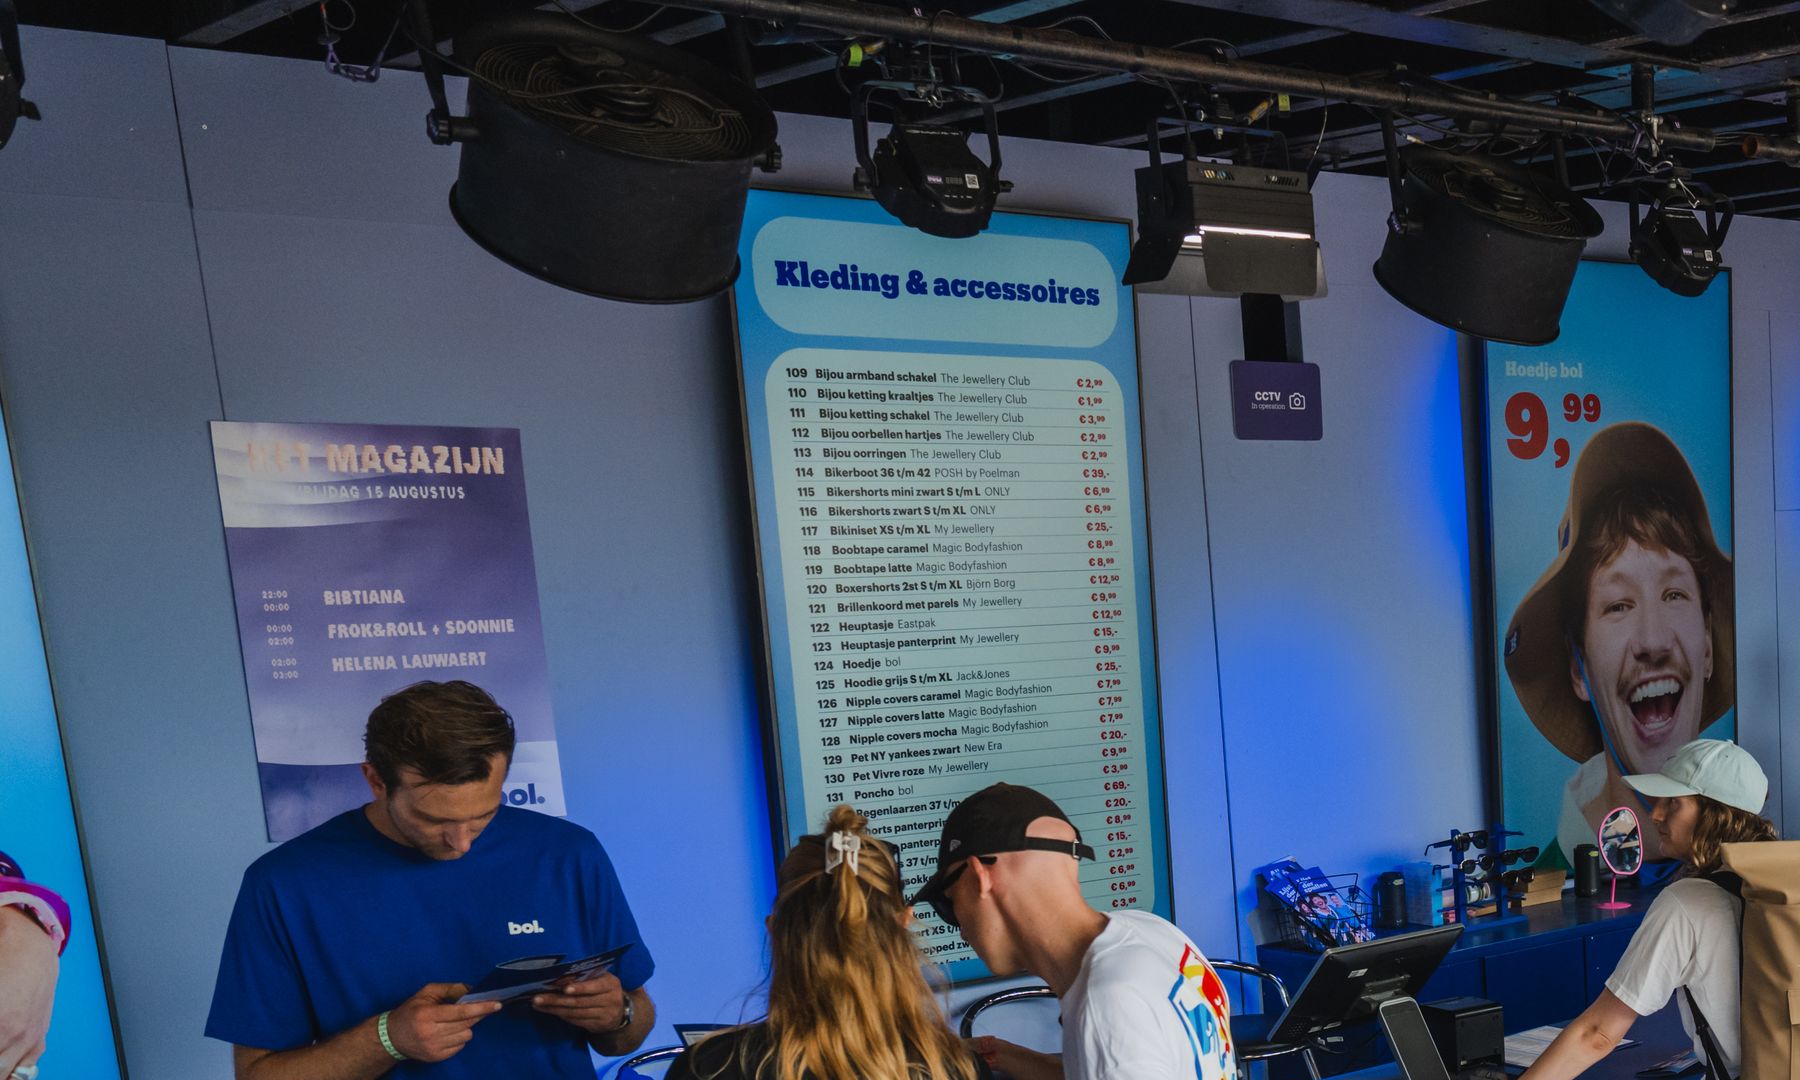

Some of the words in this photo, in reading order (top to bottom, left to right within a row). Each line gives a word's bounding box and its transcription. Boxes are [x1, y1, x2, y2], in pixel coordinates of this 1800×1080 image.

[774, 260, 900, 298] Kleding
[905, 270, 929, 295] &
[933, 277, 1100, 306] accessoires
[786, 368, 807, 378] 109
[816, 368, 844, 381] Bijou
[846, 370, 894, 381] armband
[896, 371, 936, 382] schakel
[940, 372, 958, 383] The
[962, 374, 1005, 386] Jewellery
[1008, 376, 1030, 385] Club
[1505, 361, 1558, 381] Hoedje
[1560, 362, 1583, 378] bol
[788, 387, 806, 398] 110
[817, 388, 845, 400] Bijou
[848, 389, 886, 402] ketting
[888, 390, 934, 403] kraaltjes
[938, 392, 955, 402] The
[958, 393, 1002, 405] Jewellery
[1005, 394, 1027, 404] Club
[1255, 391, 1281, 401] CCTV
[1258, 403, 1286, 411] operation
[792, 427, 809, 437] 112
[821, 428, 849, 440] Bijou
[851, 428, 903, 439] oorbellen
[905, 429, 941, 441] hartjes
[945, 430, 963, 440] The
[966, 430, 1009, 442] Jewellery
[1012, 431, 1034, 441] Club
[1504, 391, 1601, 468] 9,99
[327, 443, 505, 475] MAGAZIJN
[794, 447, 811, 457] 113
[823, 447, 851, 459] Bijou
[853, 448, 906, 460] oorringen
[910, 448, 928, 458] The
[932, 448, 976, 460] Jewellery
[979, 448, 1001, 459] Club
[366, 486, 384, 500] 15
[389, 485, 466, 500] AUGUSTUS
[803, 545, 821, 555] 118
[832, 544, 884, 556] Boobtape
[887, 543, 928, 553] caramel
[933, 543, 962, 554] Magic
[965, 541, 1022, 552] Bodyfashion
[805, 565, 822, 575] 119
[834, 564, 886, 575] Boobtape
[888, 563, 912, 572] latte
[916, 562, 945, 573] Magic
[949, 560, 1007, 572] Bodyfashion
[323, 589, 405, 606] BIBTIANA
[808, 603, 825, 613] 121
[837, 600, 903, 612] Brillenkoord
[905, 600, 925, 609] met
[928, 598, 959, 610] parels
[963, 598, 976, 608] My
[980, 596, 1022, 606] Jewellery
[328, 622, 427, 639] FROK&ROLL
[445, 619, 515, 634] SDONNIE
[810, 622, 830, 632] 122
[839, 619, 893, 632] Heuptasje
[898, 617, 936, 629] Eastpak
[812, 642, 831, 652] 123
[841, 638, 895, 651] Heuptasje
[897, 635, 956, 649] panterprint
[960, 634, 973, 645] My
[976, 632, 1019, 643] Jewellery
[332, 656, 398, 672] HELENA
[401, 652, 487, 670] LAUWAERT
[814, 661, 834, 671] 124
[843, 657, 881, 669] Hoedje
[885, 656, 900, 667] bol
[817, 698, 837, 709] 126
[846, 695, 881, 708] Nipple
[883, 695, 918, 704] covers
[920, 689, 961, 701] caramel
[965, 688, 993, 700] Magic
[996, 684, 1052, 697] Bodyfashion
[819, 717, 837, 728] 127
[848, 714, 883, 726] Nipple
[885, 713, 919, 722] covers
[921, 710, 944, 720] latte
[949, 706, 977, 718] Magic
[980, 703, 1036, 718] Bodyfashion
[825, 773, 845, 784] 130
[853, 772, 870, 781] Pet
[872, 769, 900, 779] Vivre
[902, 768, 924, 776] roze
[929, 764, 942, 775] My
[945, 760, 988, 773] Jewellery
[826, 792, 843, 802] 131
[854, 787, 894, 800] Poncho
[898, 784, 913, 795] bol
[857, 803, 927, 819] Regenlaarzen
[929, 801, 941, 810] 37
[508, 920, 545, 935] bol.
